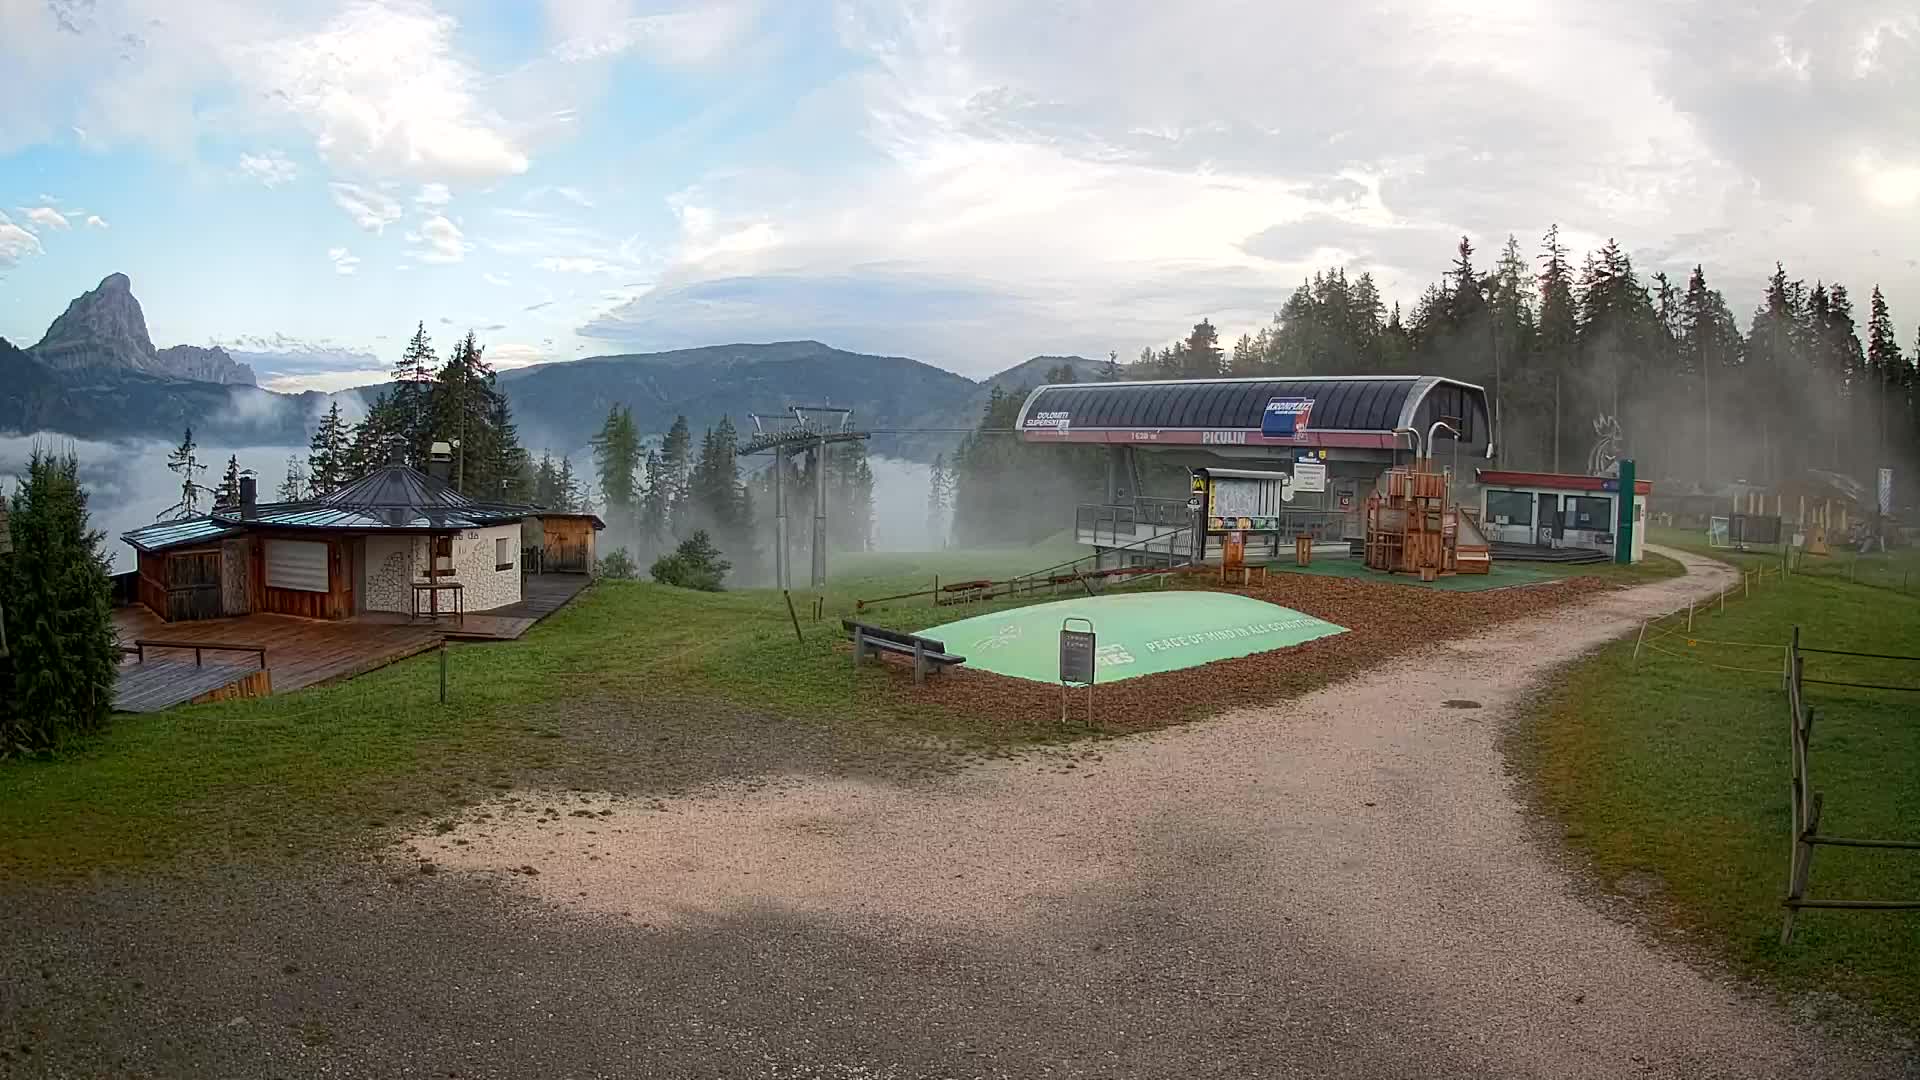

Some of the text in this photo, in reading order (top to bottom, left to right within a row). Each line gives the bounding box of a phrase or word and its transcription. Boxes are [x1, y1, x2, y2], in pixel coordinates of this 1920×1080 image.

[1037, 411, 1069, 419] DOLOMITI
[1202, 431, 1247, 444] PICULIN
[1145, 618, 1322, 652] PEACE OF MIND IN ALL CONDITION
